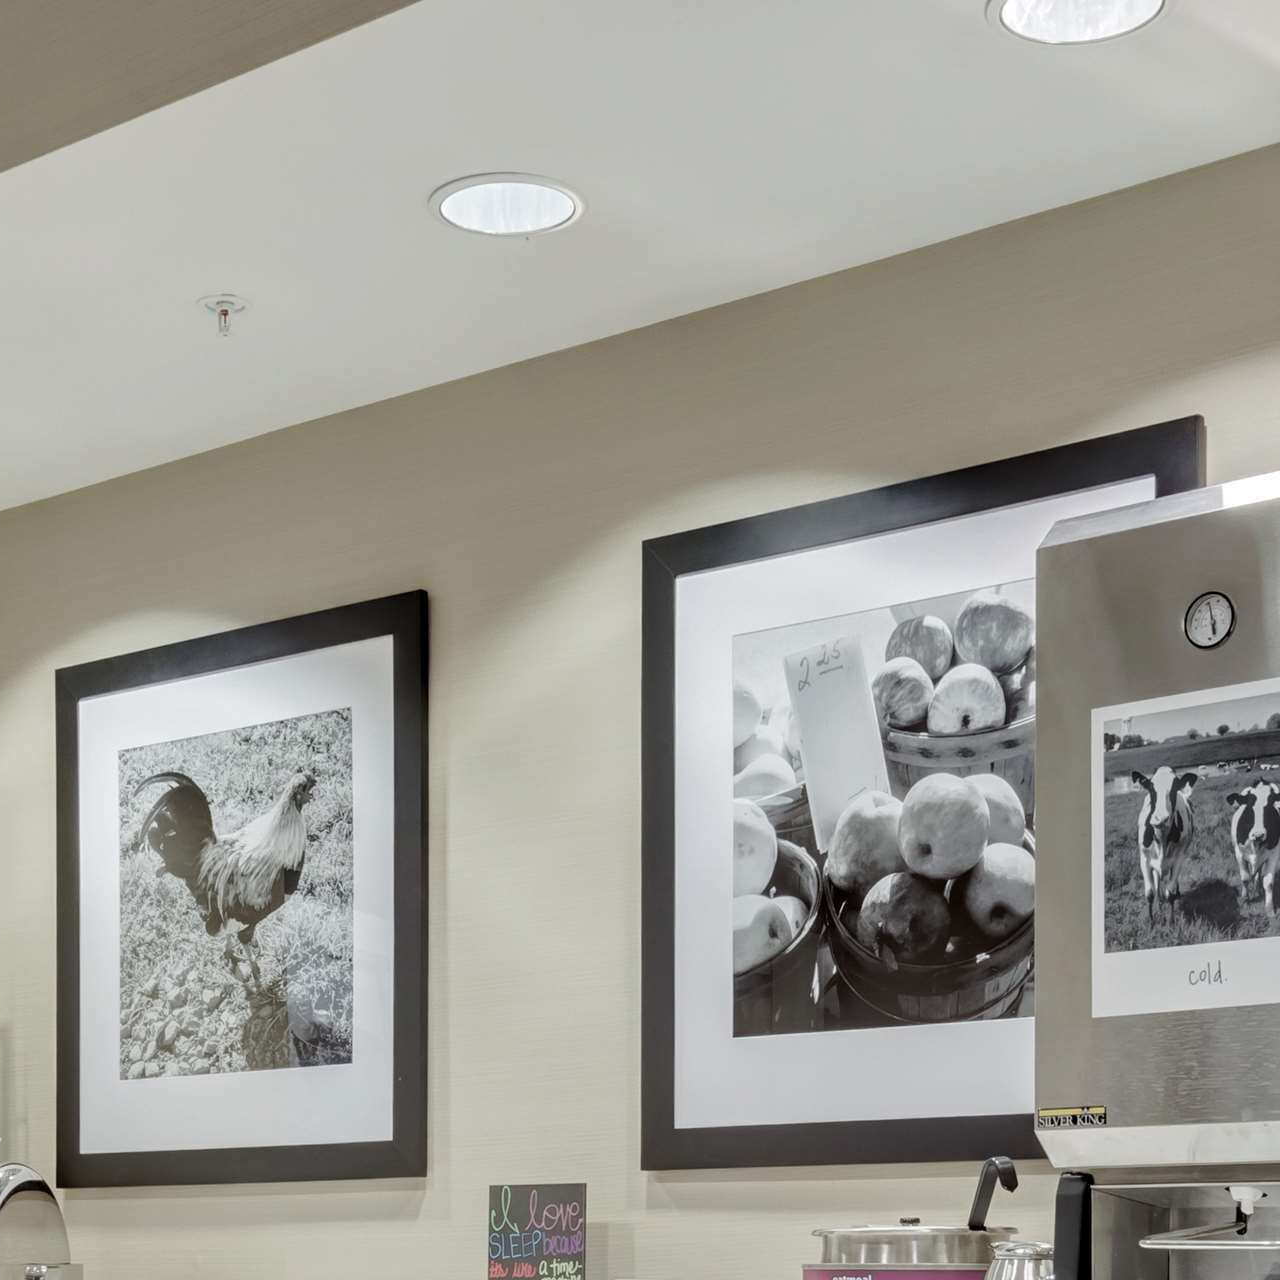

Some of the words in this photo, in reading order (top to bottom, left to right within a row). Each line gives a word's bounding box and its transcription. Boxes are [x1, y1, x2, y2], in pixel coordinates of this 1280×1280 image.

[1188, 960, 1228, 985] cold.
[1039, 1114, 1074, 1128] SILVER
[1076, 1113, 1104, 1126] KING
[491, 1186, 519, 1233] I
[525, 1189, 584, 1231] love
[489, 1230, 542, 1259] SLEEP
[512, 1261, 537, 1278] like
